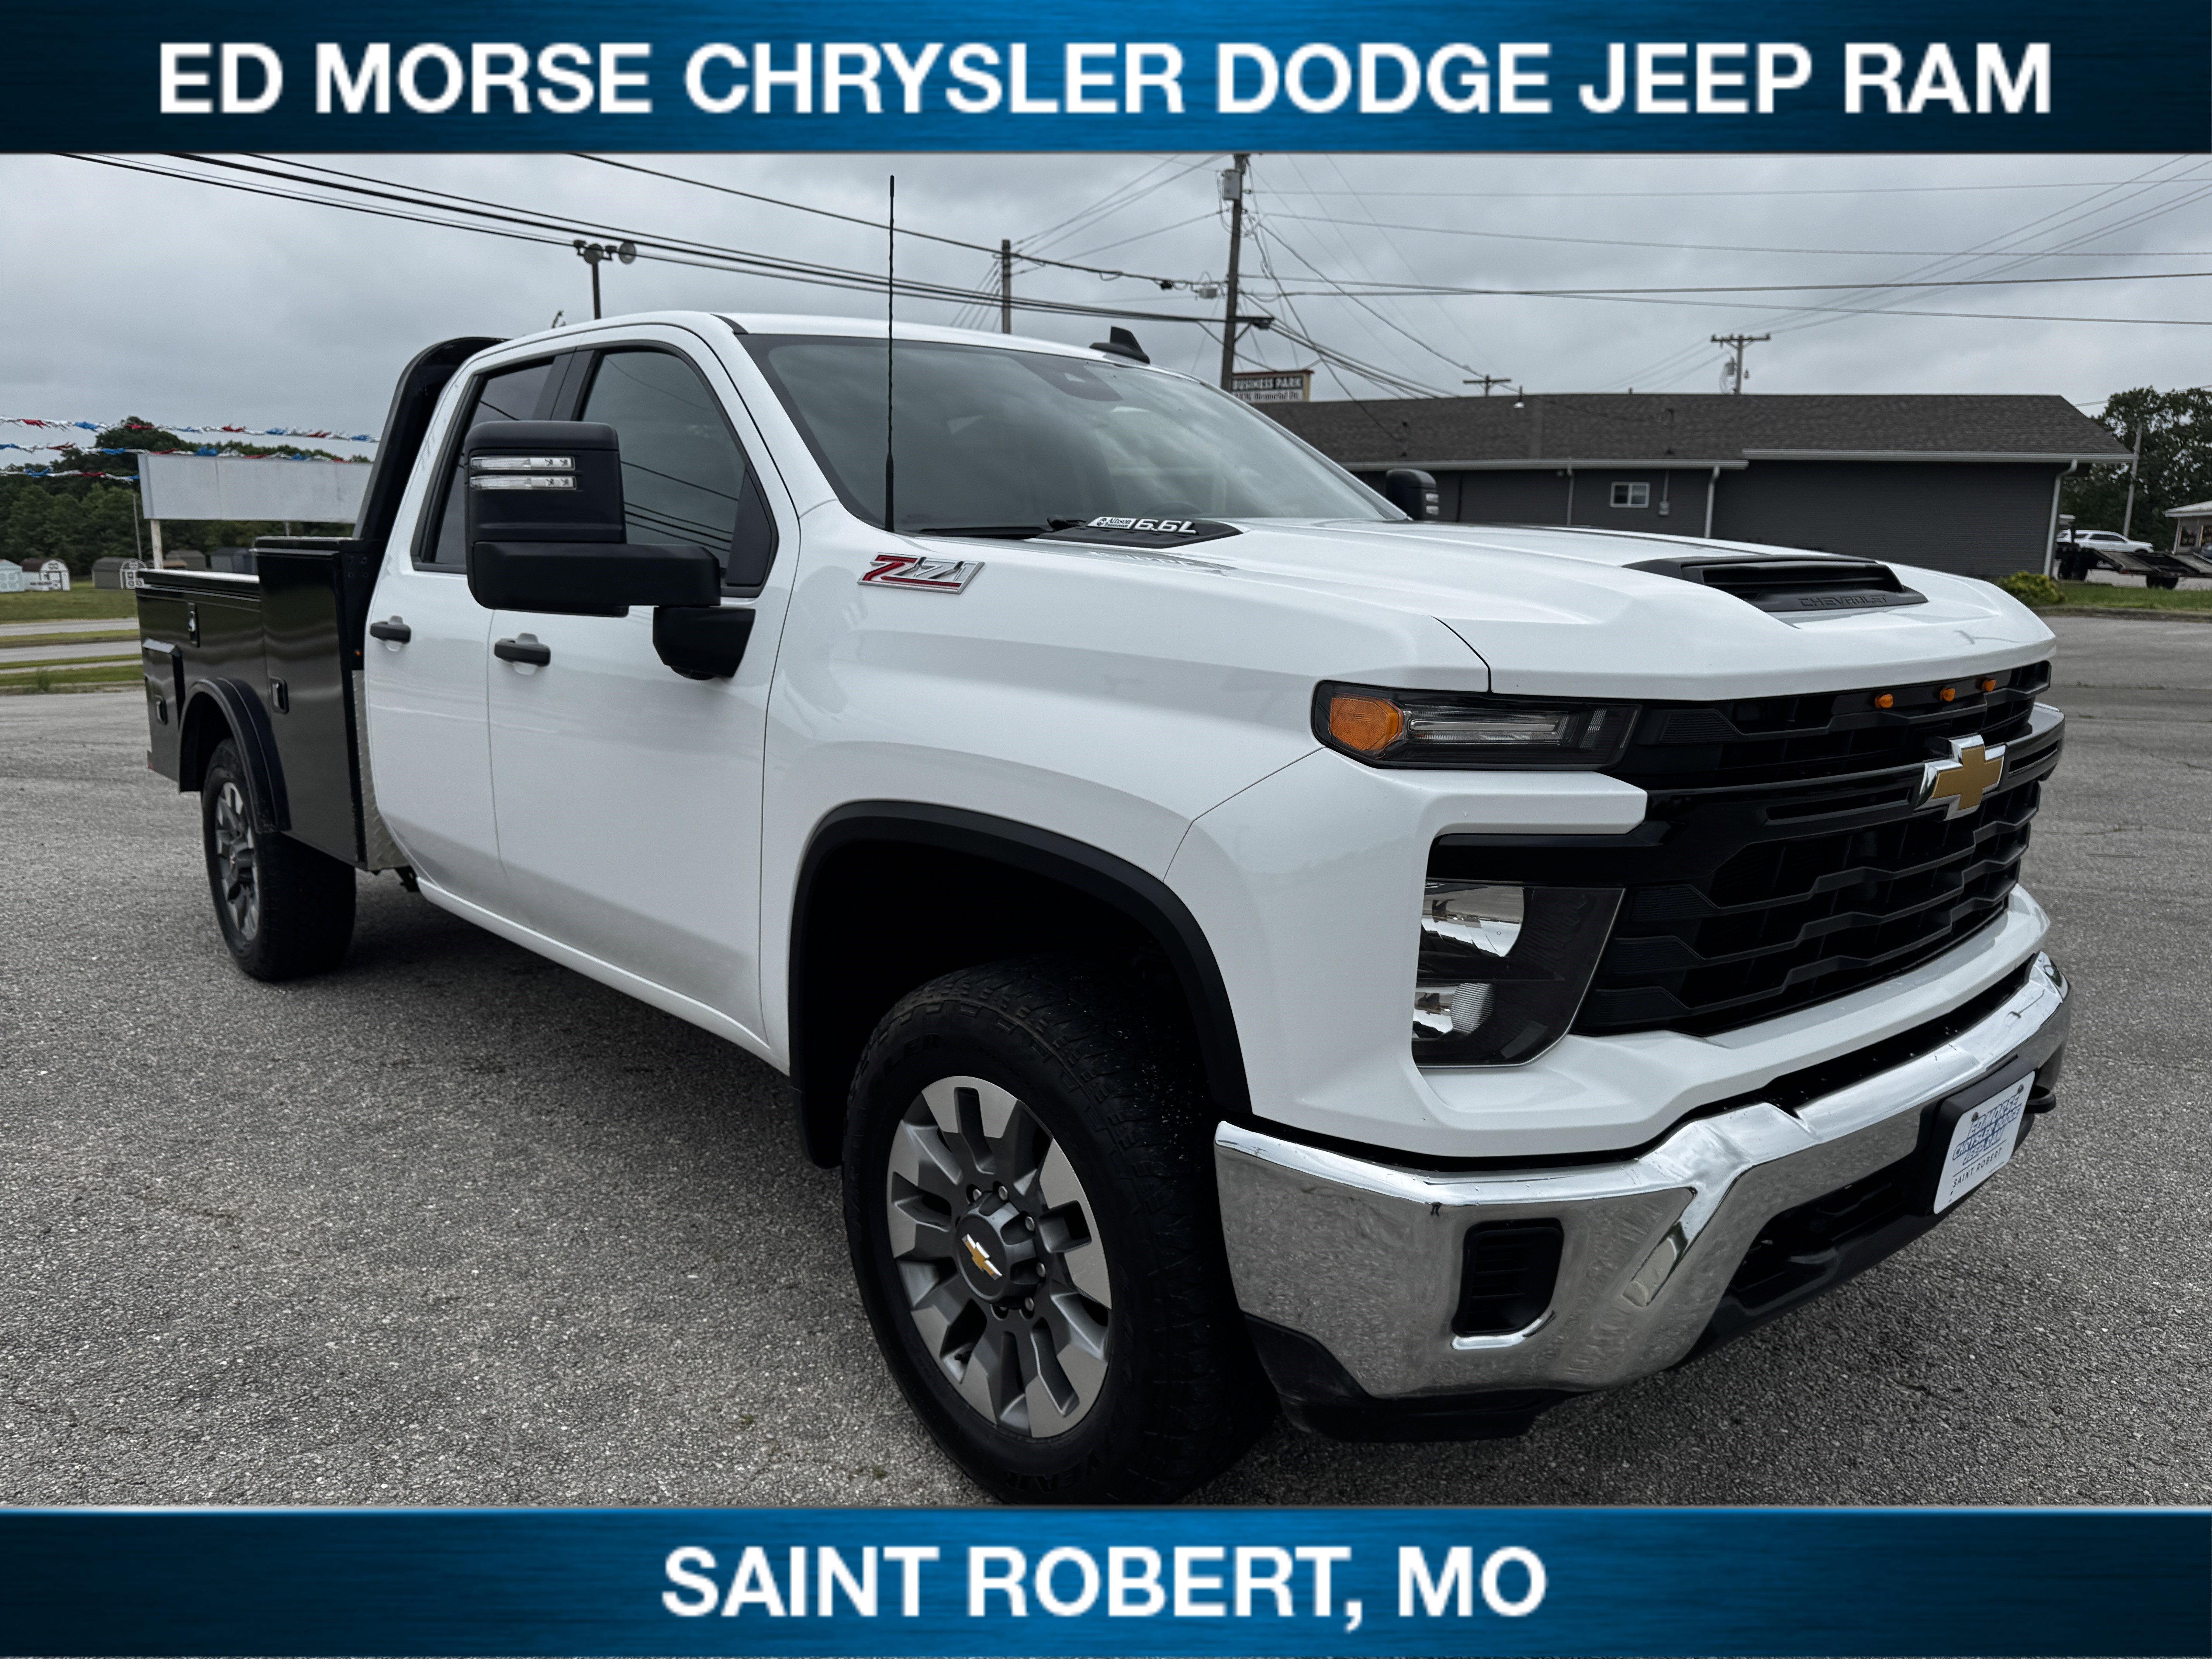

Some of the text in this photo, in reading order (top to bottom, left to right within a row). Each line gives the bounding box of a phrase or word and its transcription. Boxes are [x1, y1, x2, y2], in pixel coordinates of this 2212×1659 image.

[1275, 377, 1302, 388] PARK
[1133, 518, 1198, 534] 6.6L
[857, 552, 985, 594] Z71
[1798, 594, 1887, 607] CHEVROLET
[1968, 1093, 2020, 1139] ED MORSE
[1953, 1147, 2002, 1188] SAINT ROBERT
